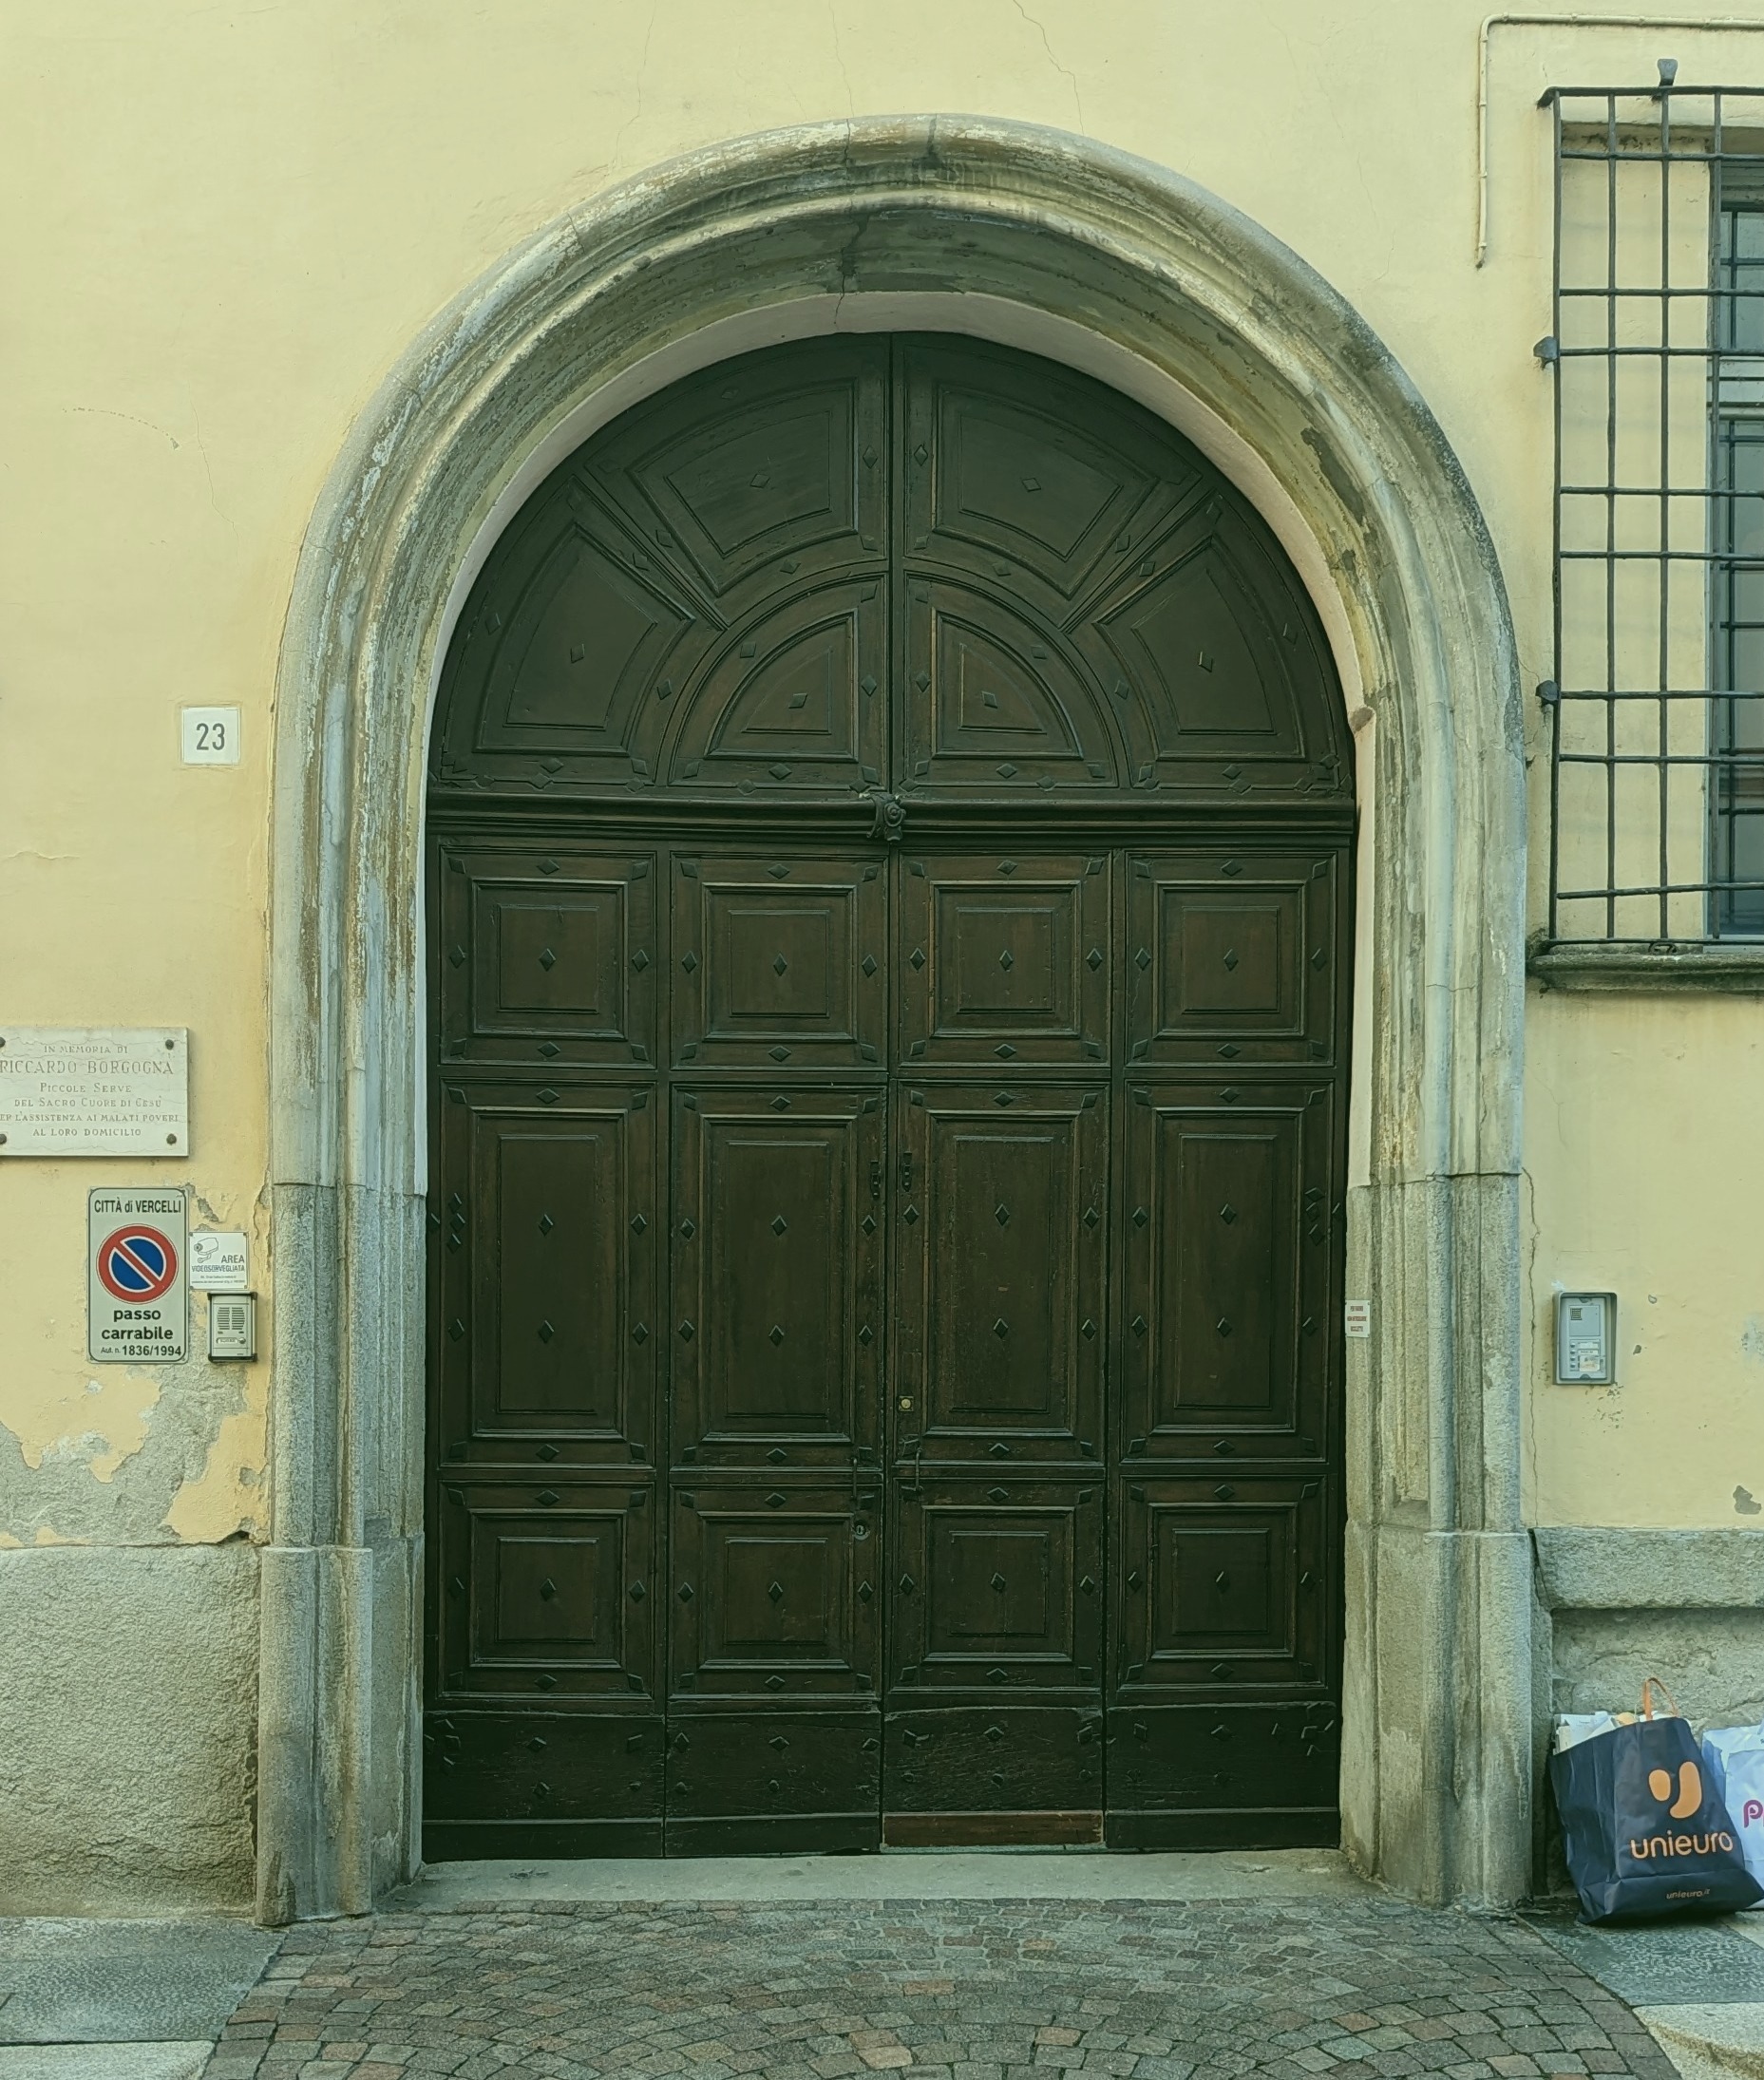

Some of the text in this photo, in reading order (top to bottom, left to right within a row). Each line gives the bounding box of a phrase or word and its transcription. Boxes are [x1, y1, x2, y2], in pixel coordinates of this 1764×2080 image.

[196, 722, 225, 750] 23
[0, 1060, 174, 1074] RICCARDO BORGOGNA
[32, 1128, 142, 1137] AL LORO DOMICILIO
[94, 1197, 181, 1214] CITTÀ di VERCELLI
[220, 1255, 245, 1264] AREA
[113, 1310, 161, 1322] passo
[101, 1327, 174, 1340] carrabile
[123, 1345, 182, 1356] 1836/1994
[1630, 1830, 1734, 1859] unieuro
